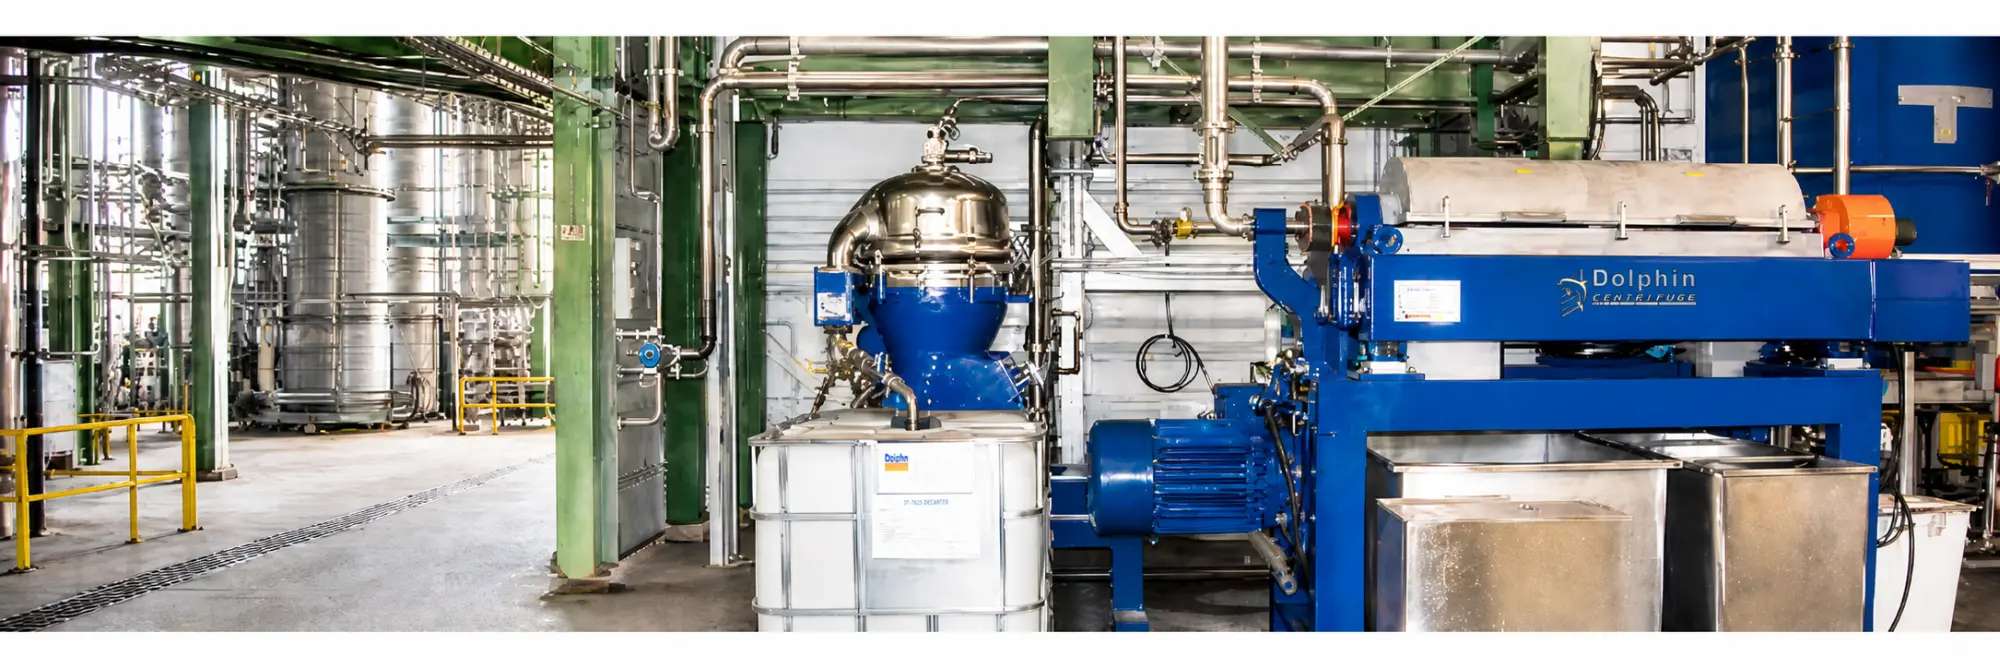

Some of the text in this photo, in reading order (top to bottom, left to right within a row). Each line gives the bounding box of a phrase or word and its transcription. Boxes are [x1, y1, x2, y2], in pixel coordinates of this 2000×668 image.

[1593, 269, 1695, 291] Dolphin
[1592, 293, 1696, 302] CENTRIFUGE
[924, 498, 949, 506] DECANTER
